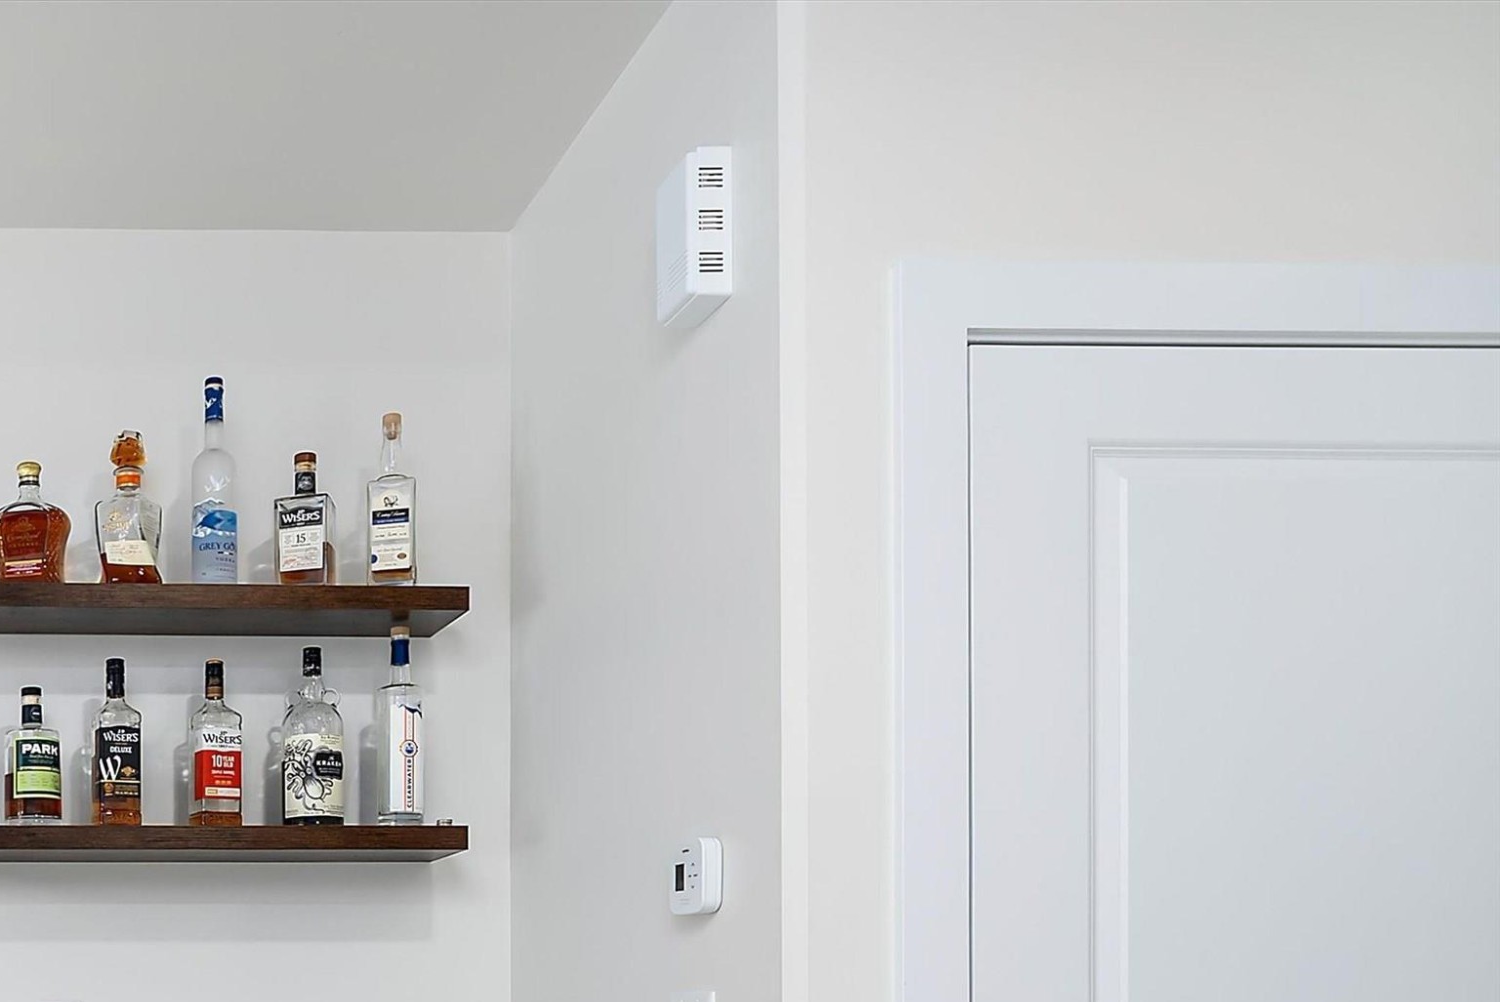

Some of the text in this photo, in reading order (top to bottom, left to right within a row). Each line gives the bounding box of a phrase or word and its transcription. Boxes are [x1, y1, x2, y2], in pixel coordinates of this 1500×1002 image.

[296, 533, 306, 544] 15
[199, 542, 220, 551] GREY
[21, 743, 58, 756] PARK
[110, 746, 132, 754] DELUXE
[211, 754, 223, 768] 10
[99, 755, 121, 781] W
